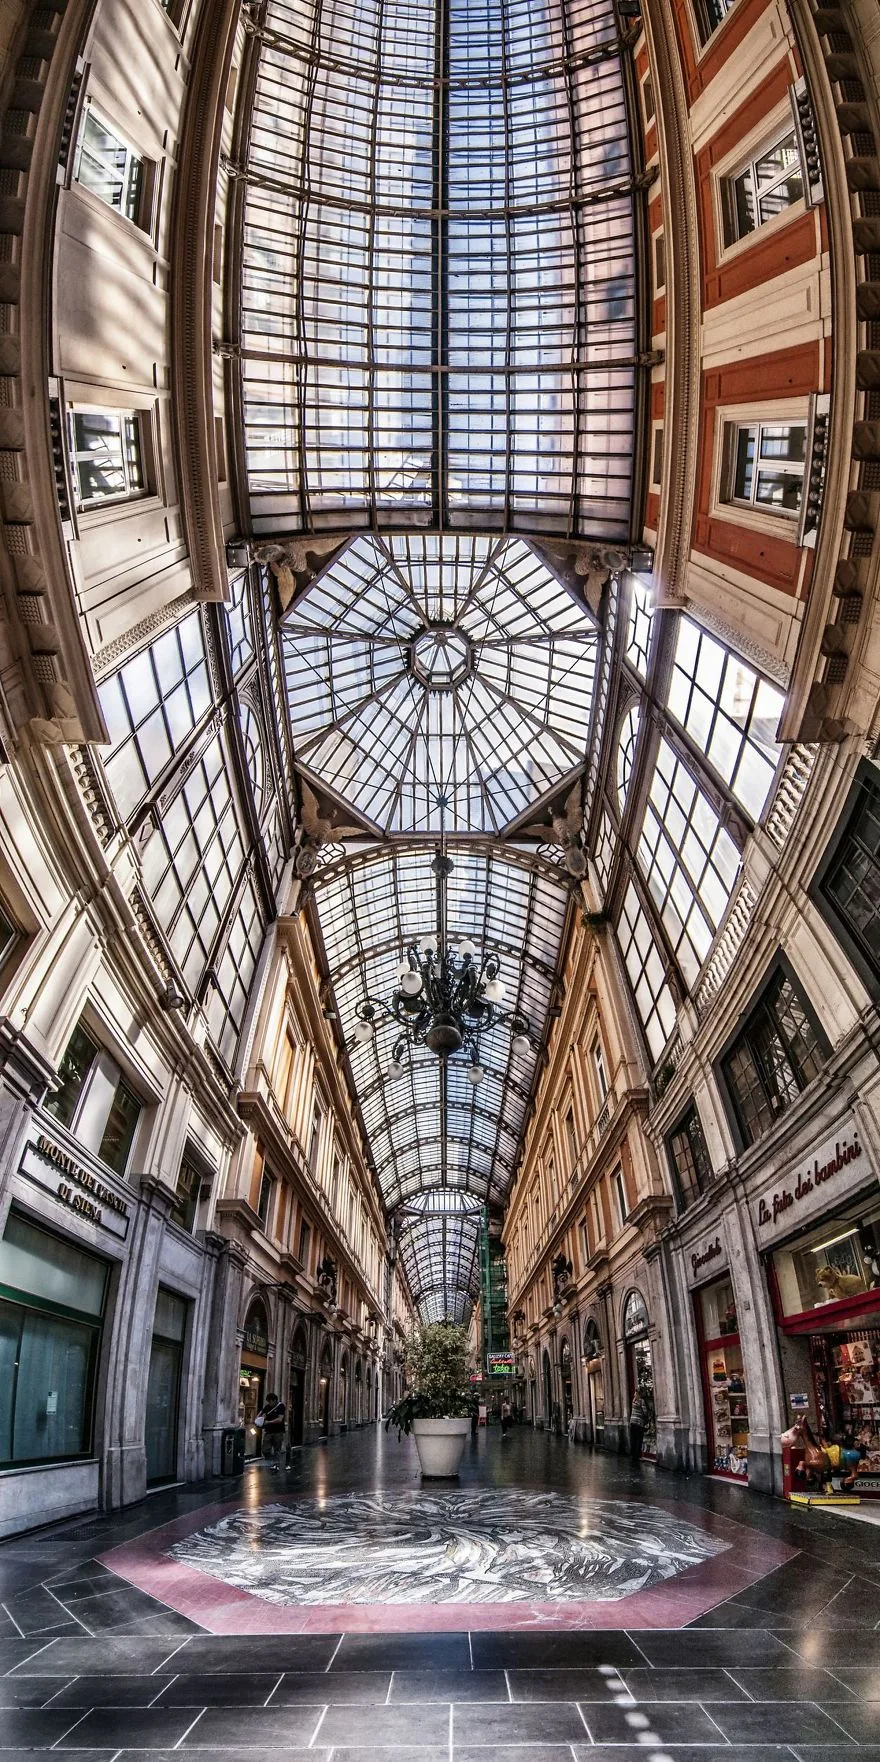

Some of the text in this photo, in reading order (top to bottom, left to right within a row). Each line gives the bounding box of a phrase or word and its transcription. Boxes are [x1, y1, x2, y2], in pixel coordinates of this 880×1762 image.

[37, 1135, 80, 1182] MONTE
[78, 1168, 99, 1196] DEI
[759, 1199, 772, 1226] La
[794, 1173, 813, 1200] dei
[814, 1132, 862, 1186] bambini
[58, 1183, 102, 1223] DI SIENA
